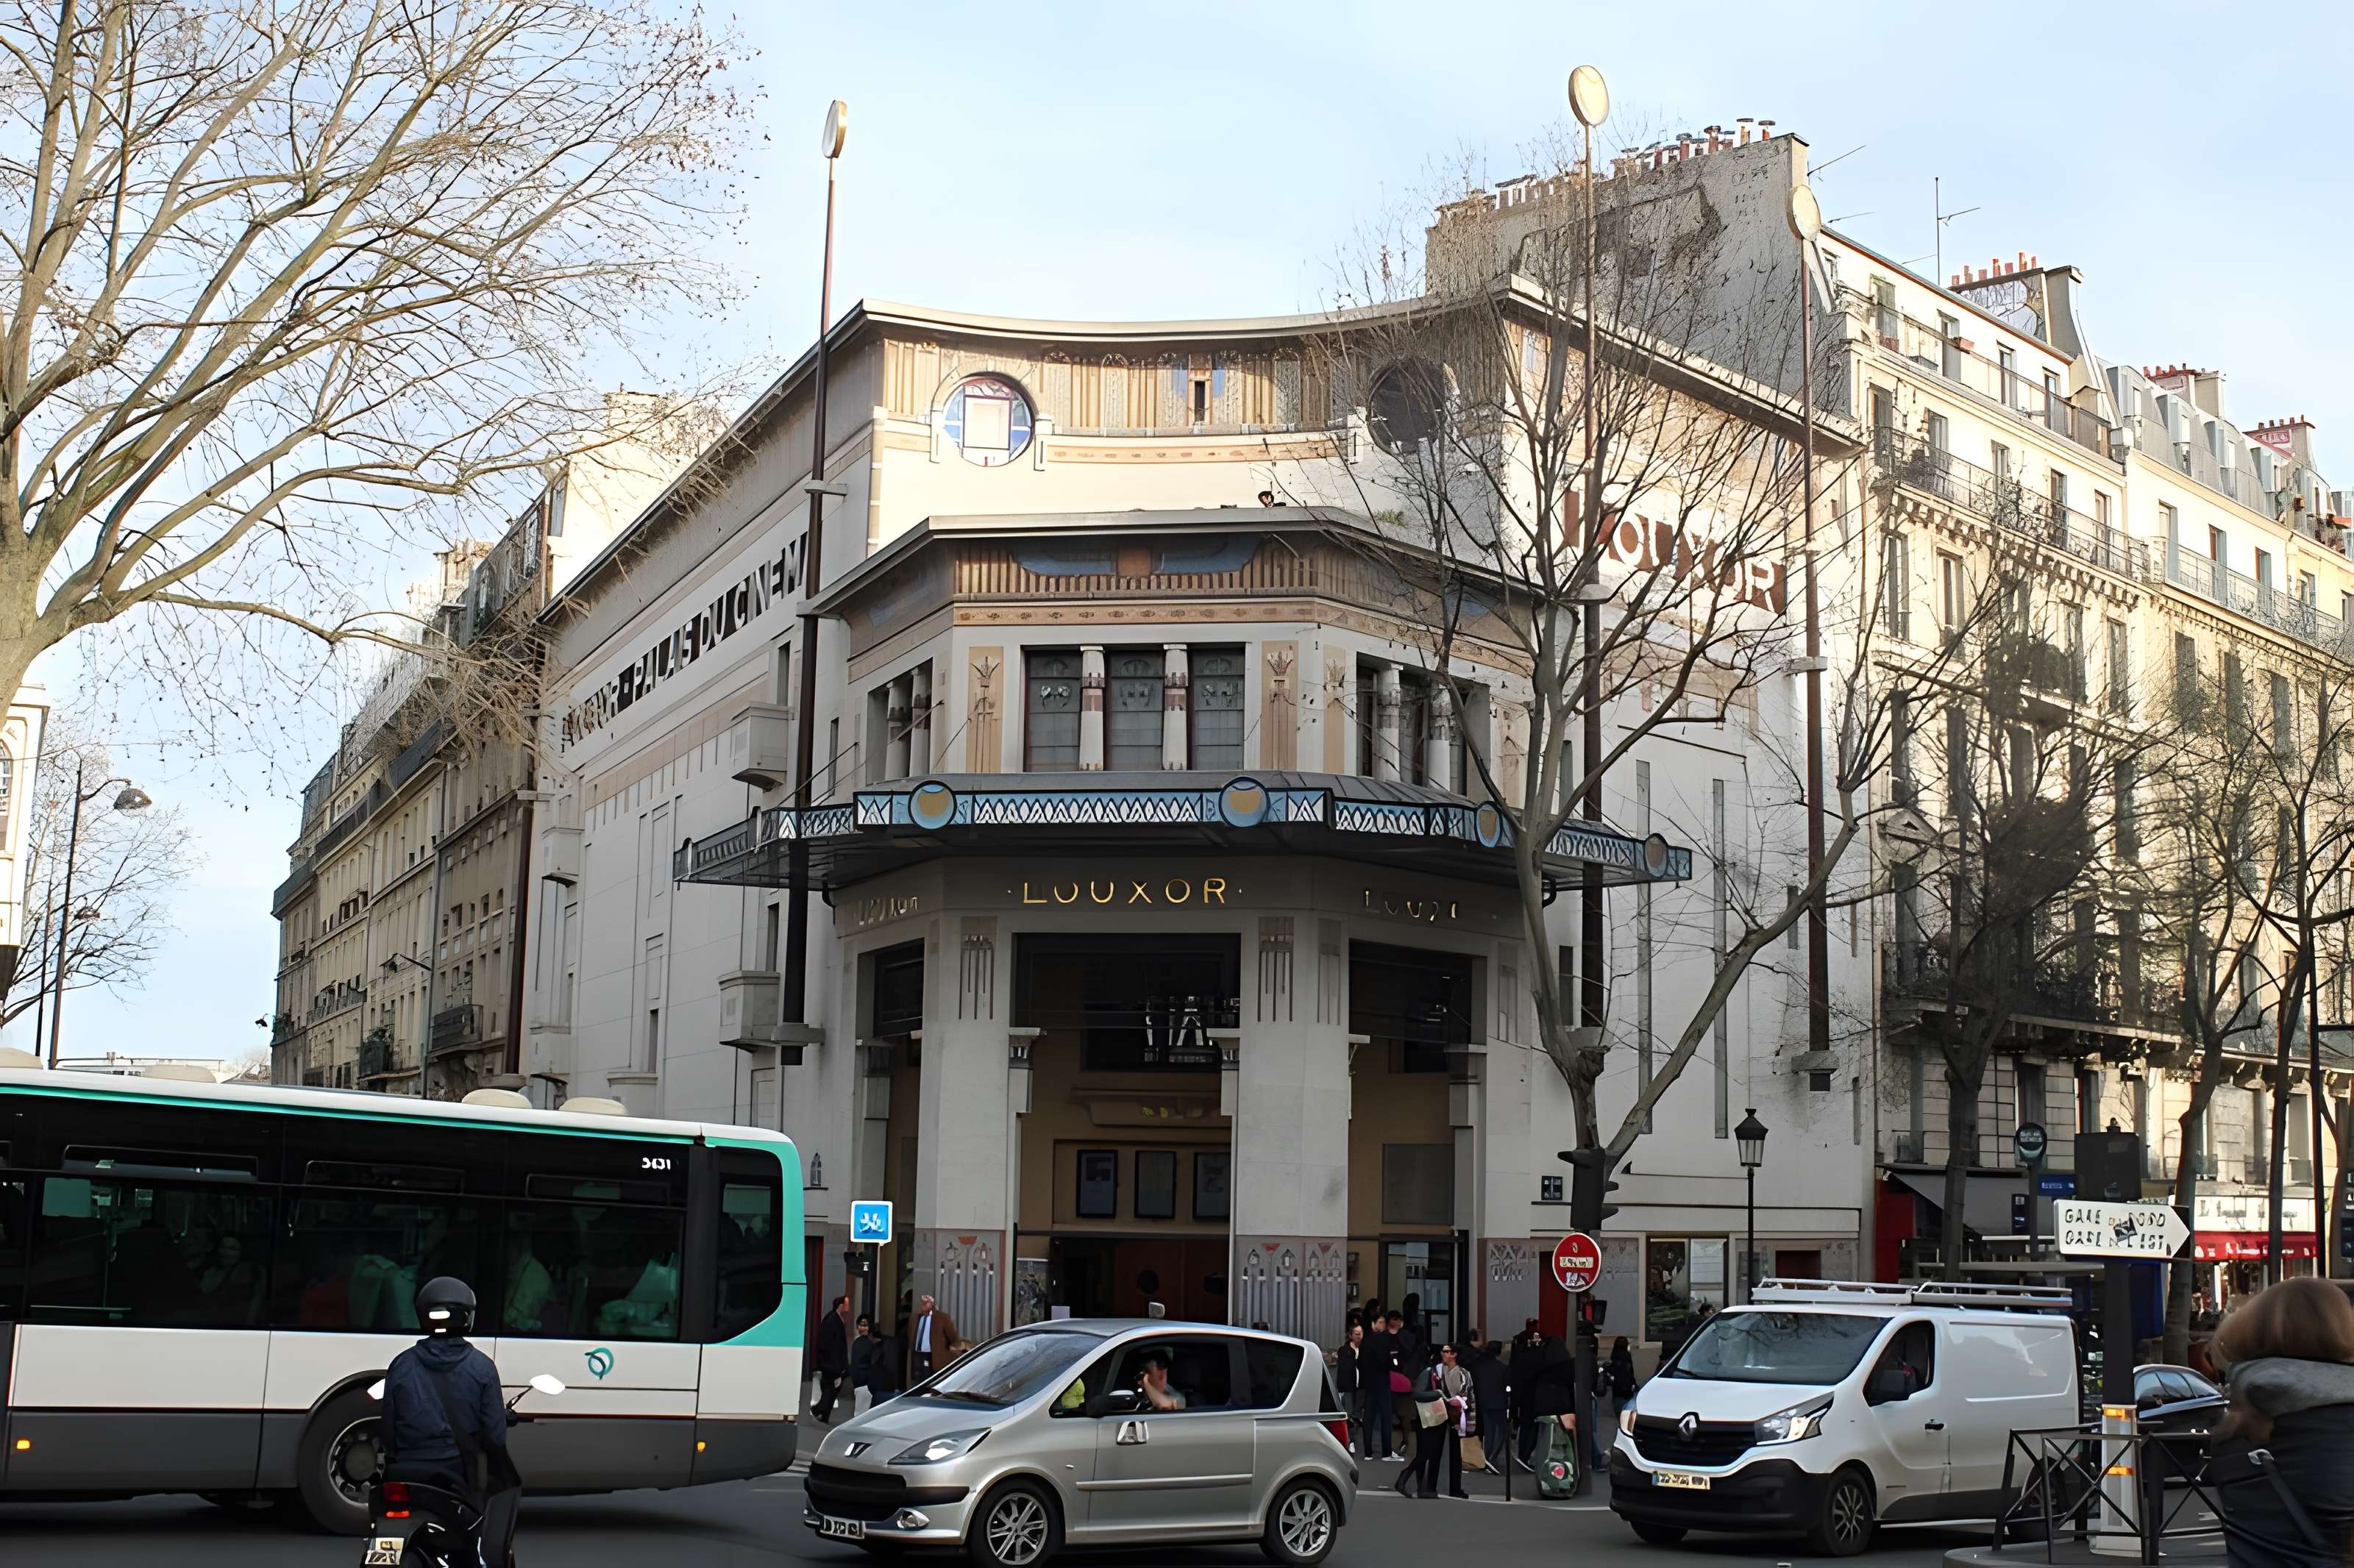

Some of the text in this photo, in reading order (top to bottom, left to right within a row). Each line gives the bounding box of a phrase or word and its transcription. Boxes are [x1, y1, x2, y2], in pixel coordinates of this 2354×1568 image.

[699, 594, 728, 657] DU
[733, 530, 809, 631] CINEM
[1023, 877, 1226, 905] LOUXOR
